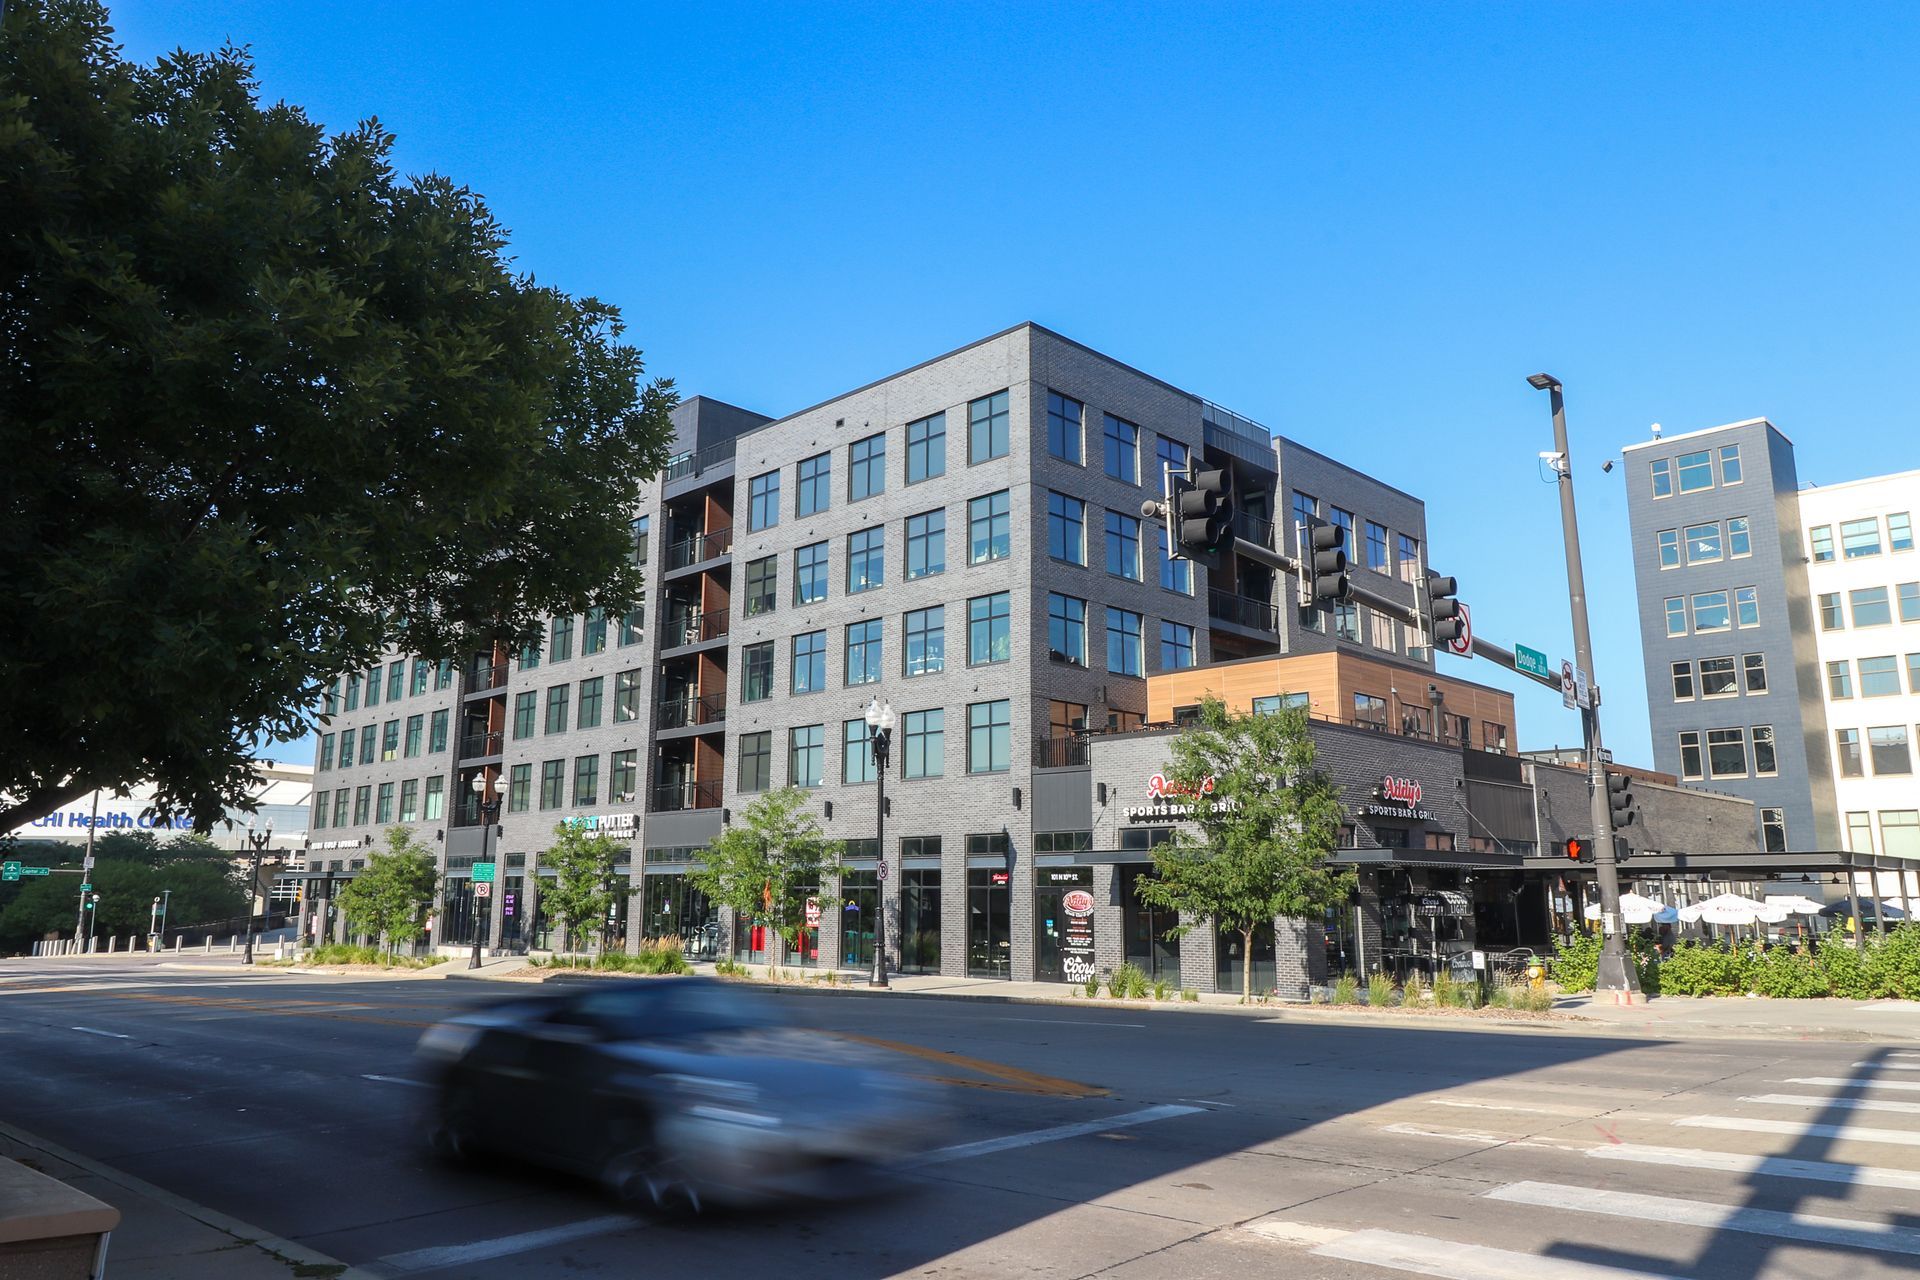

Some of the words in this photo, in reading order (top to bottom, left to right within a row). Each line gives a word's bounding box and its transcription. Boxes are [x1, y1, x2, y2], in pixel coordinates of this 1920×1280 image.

[1518, 650, 1536, 672] Dodge
[1383, 775, 1421, 809] Addy's
[1123, 805, 1168, 817] SPORTS
[1170, 804, 1195, 815] BAR
[1369, 805, 1397, 817] SPORTS
[1398, 808, 1411, 818] BAR
[1412, 810, 1418, 819] &
[1418, 811, 1437, 820] GRILL
[68, 811, 133, 829] Health
[599, 813, 634, 828] PUTTER
[1450, 904, 1467, 914] LIGHT
[1063, 957, 1095, 974] Coors
[1067, 973, 1092, 983] LIGHT
